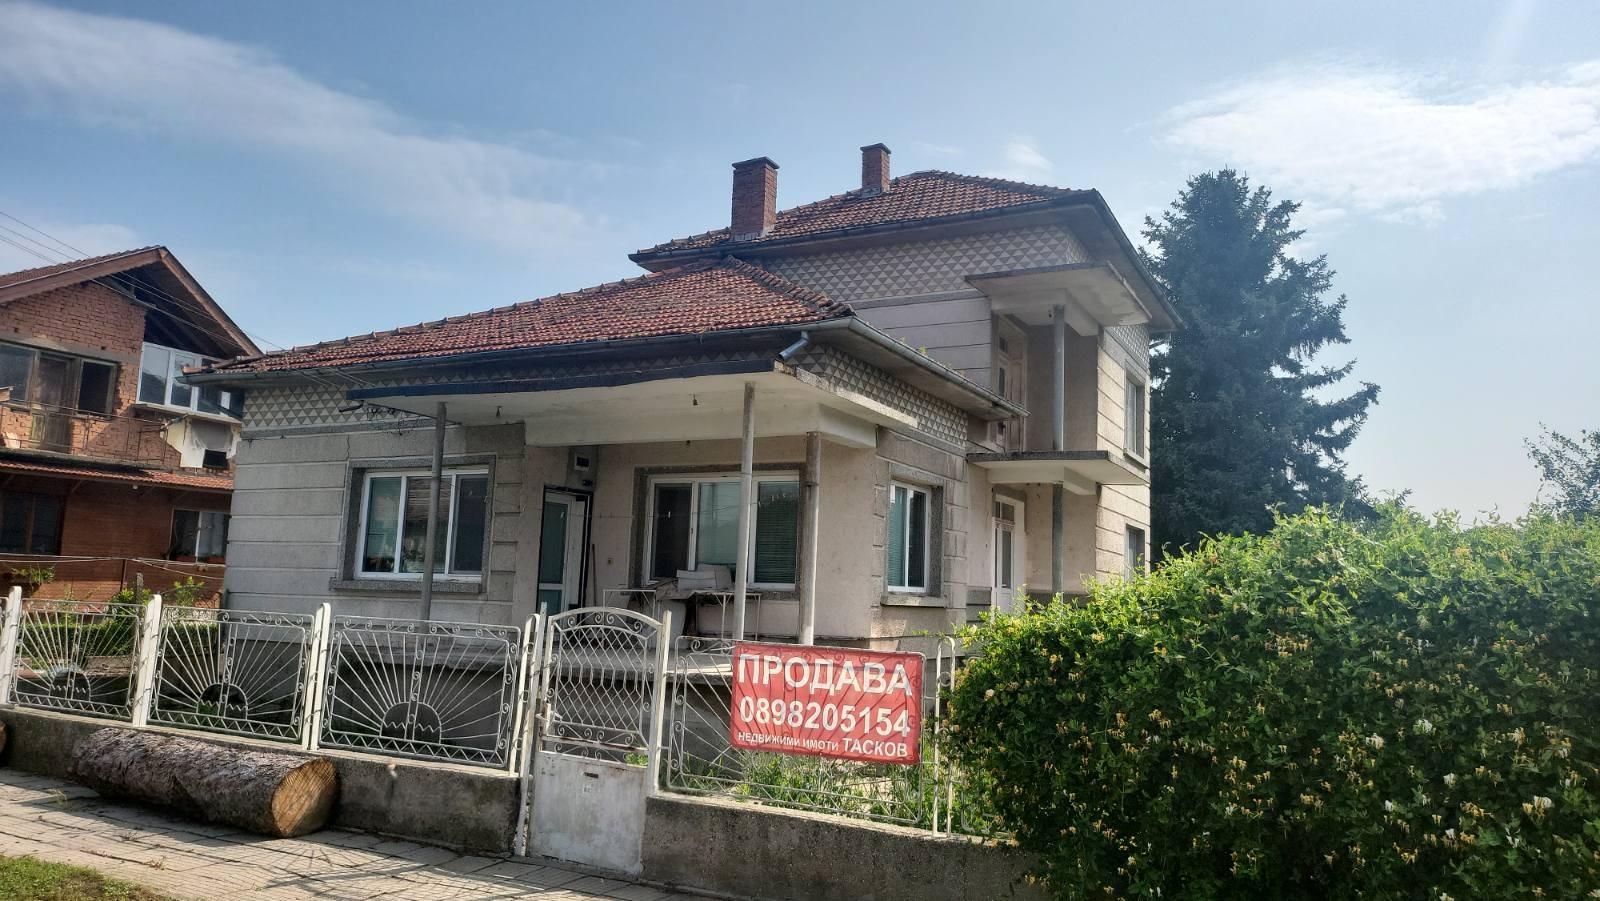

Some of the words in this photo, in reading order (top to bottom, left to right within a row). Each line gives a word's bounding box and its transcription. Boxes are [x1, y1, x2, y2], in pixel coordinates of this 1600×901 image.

[738, 653, 912, 696] ПРОДАВА
[740, 696, 911, 737] 0898205154
[738, 732, 801, 746] НЕДВИЖИМИ
[803, 739, 839, 751] ИМОТИ
[843, 737, 908, 757] ТАСКОВ
